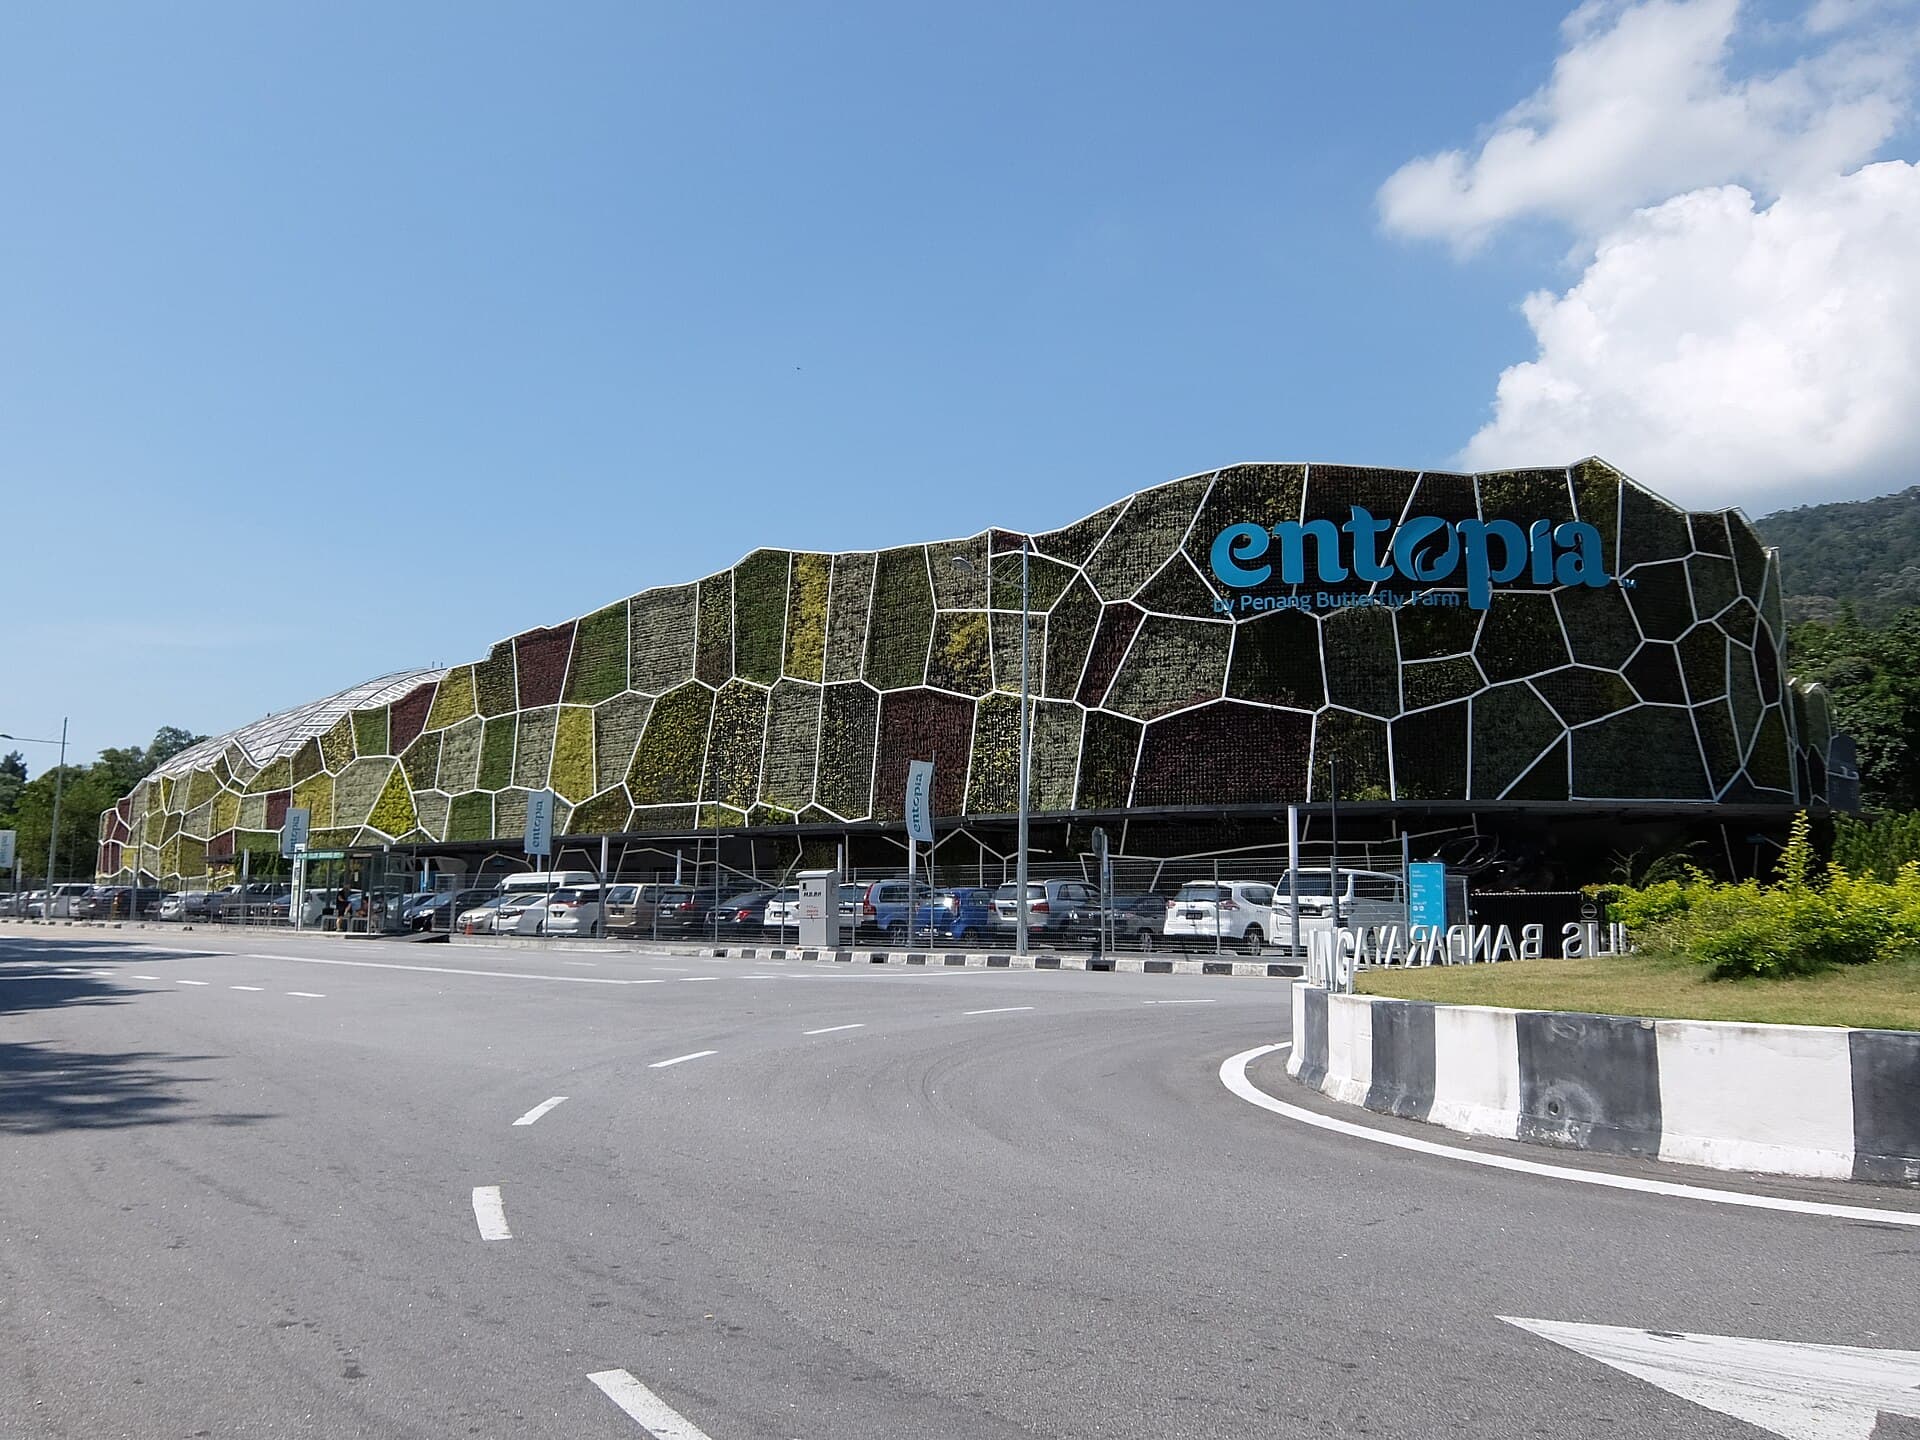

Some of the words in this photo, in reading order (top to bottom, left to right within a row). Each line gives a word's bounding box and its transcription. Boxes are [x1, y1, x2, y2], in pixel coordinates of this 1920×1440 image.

[1210, 505, 1611, 609] entopia
[1213, 596, 1235, 614] by
[1240, 595, 1310, 612] Penang
[1317, 590, 1403, 608] Butterfly
[1412, 591, 1460, 607] Farm
[532, 801, 544, 848] entopia
[911, 773, 923, 833] entopia
